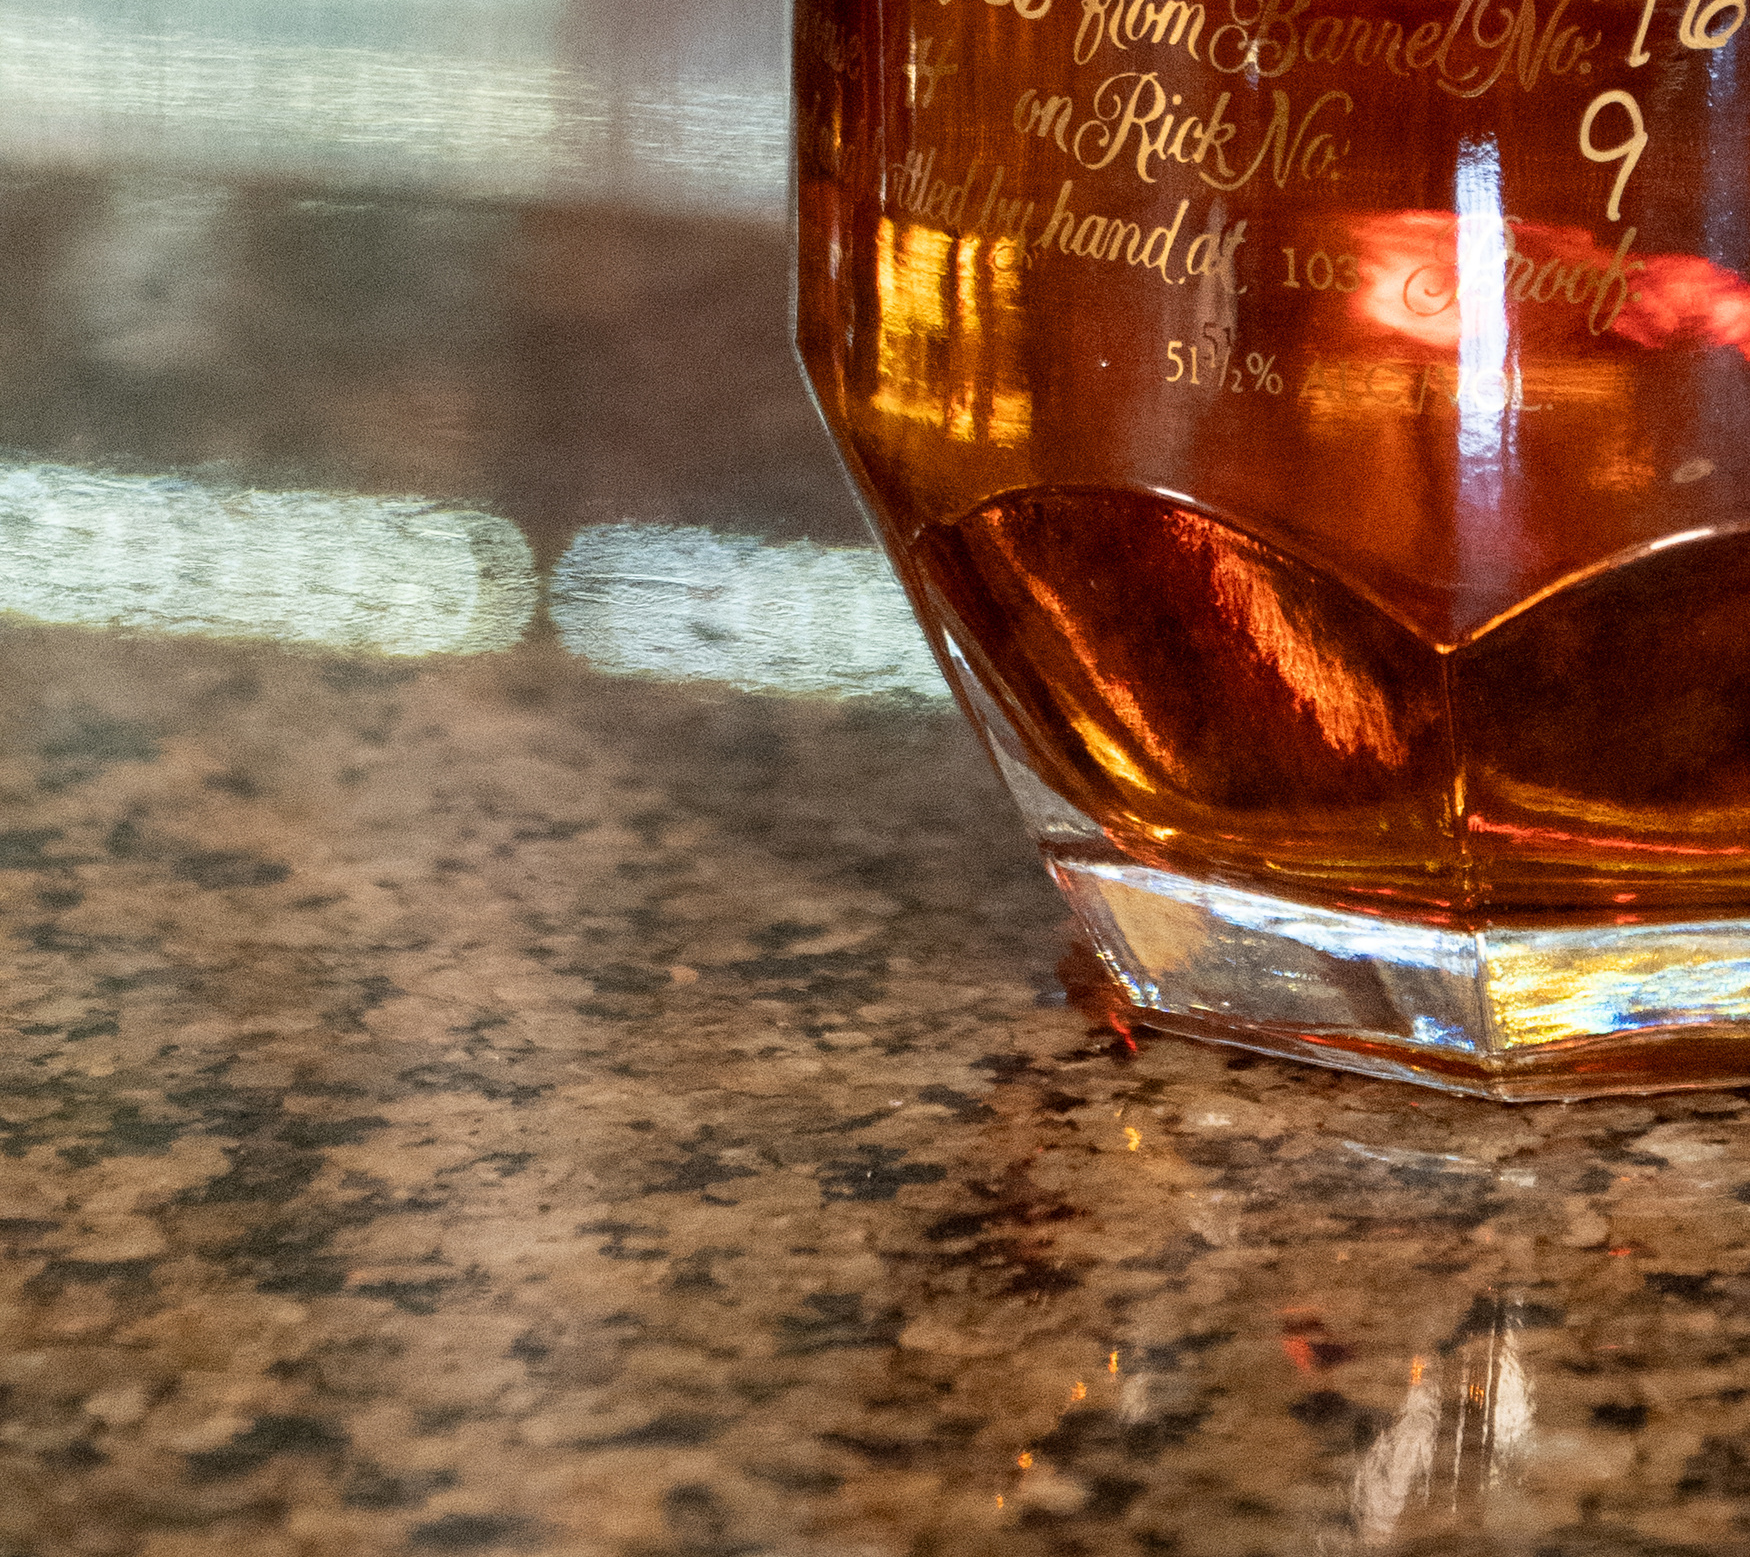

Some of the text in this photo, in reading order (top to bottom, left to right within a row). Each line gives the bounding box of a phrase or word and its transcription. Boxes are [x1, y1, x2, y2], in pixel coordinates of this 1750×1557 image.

[1013, 86, 1074, 154] on
[1074, 70, 1236, 184] Rick
[1579, 89, 1649, 223] 9
[1035, 179, 1189, 285] hand
[1281, 246, 1362, 294] 103
